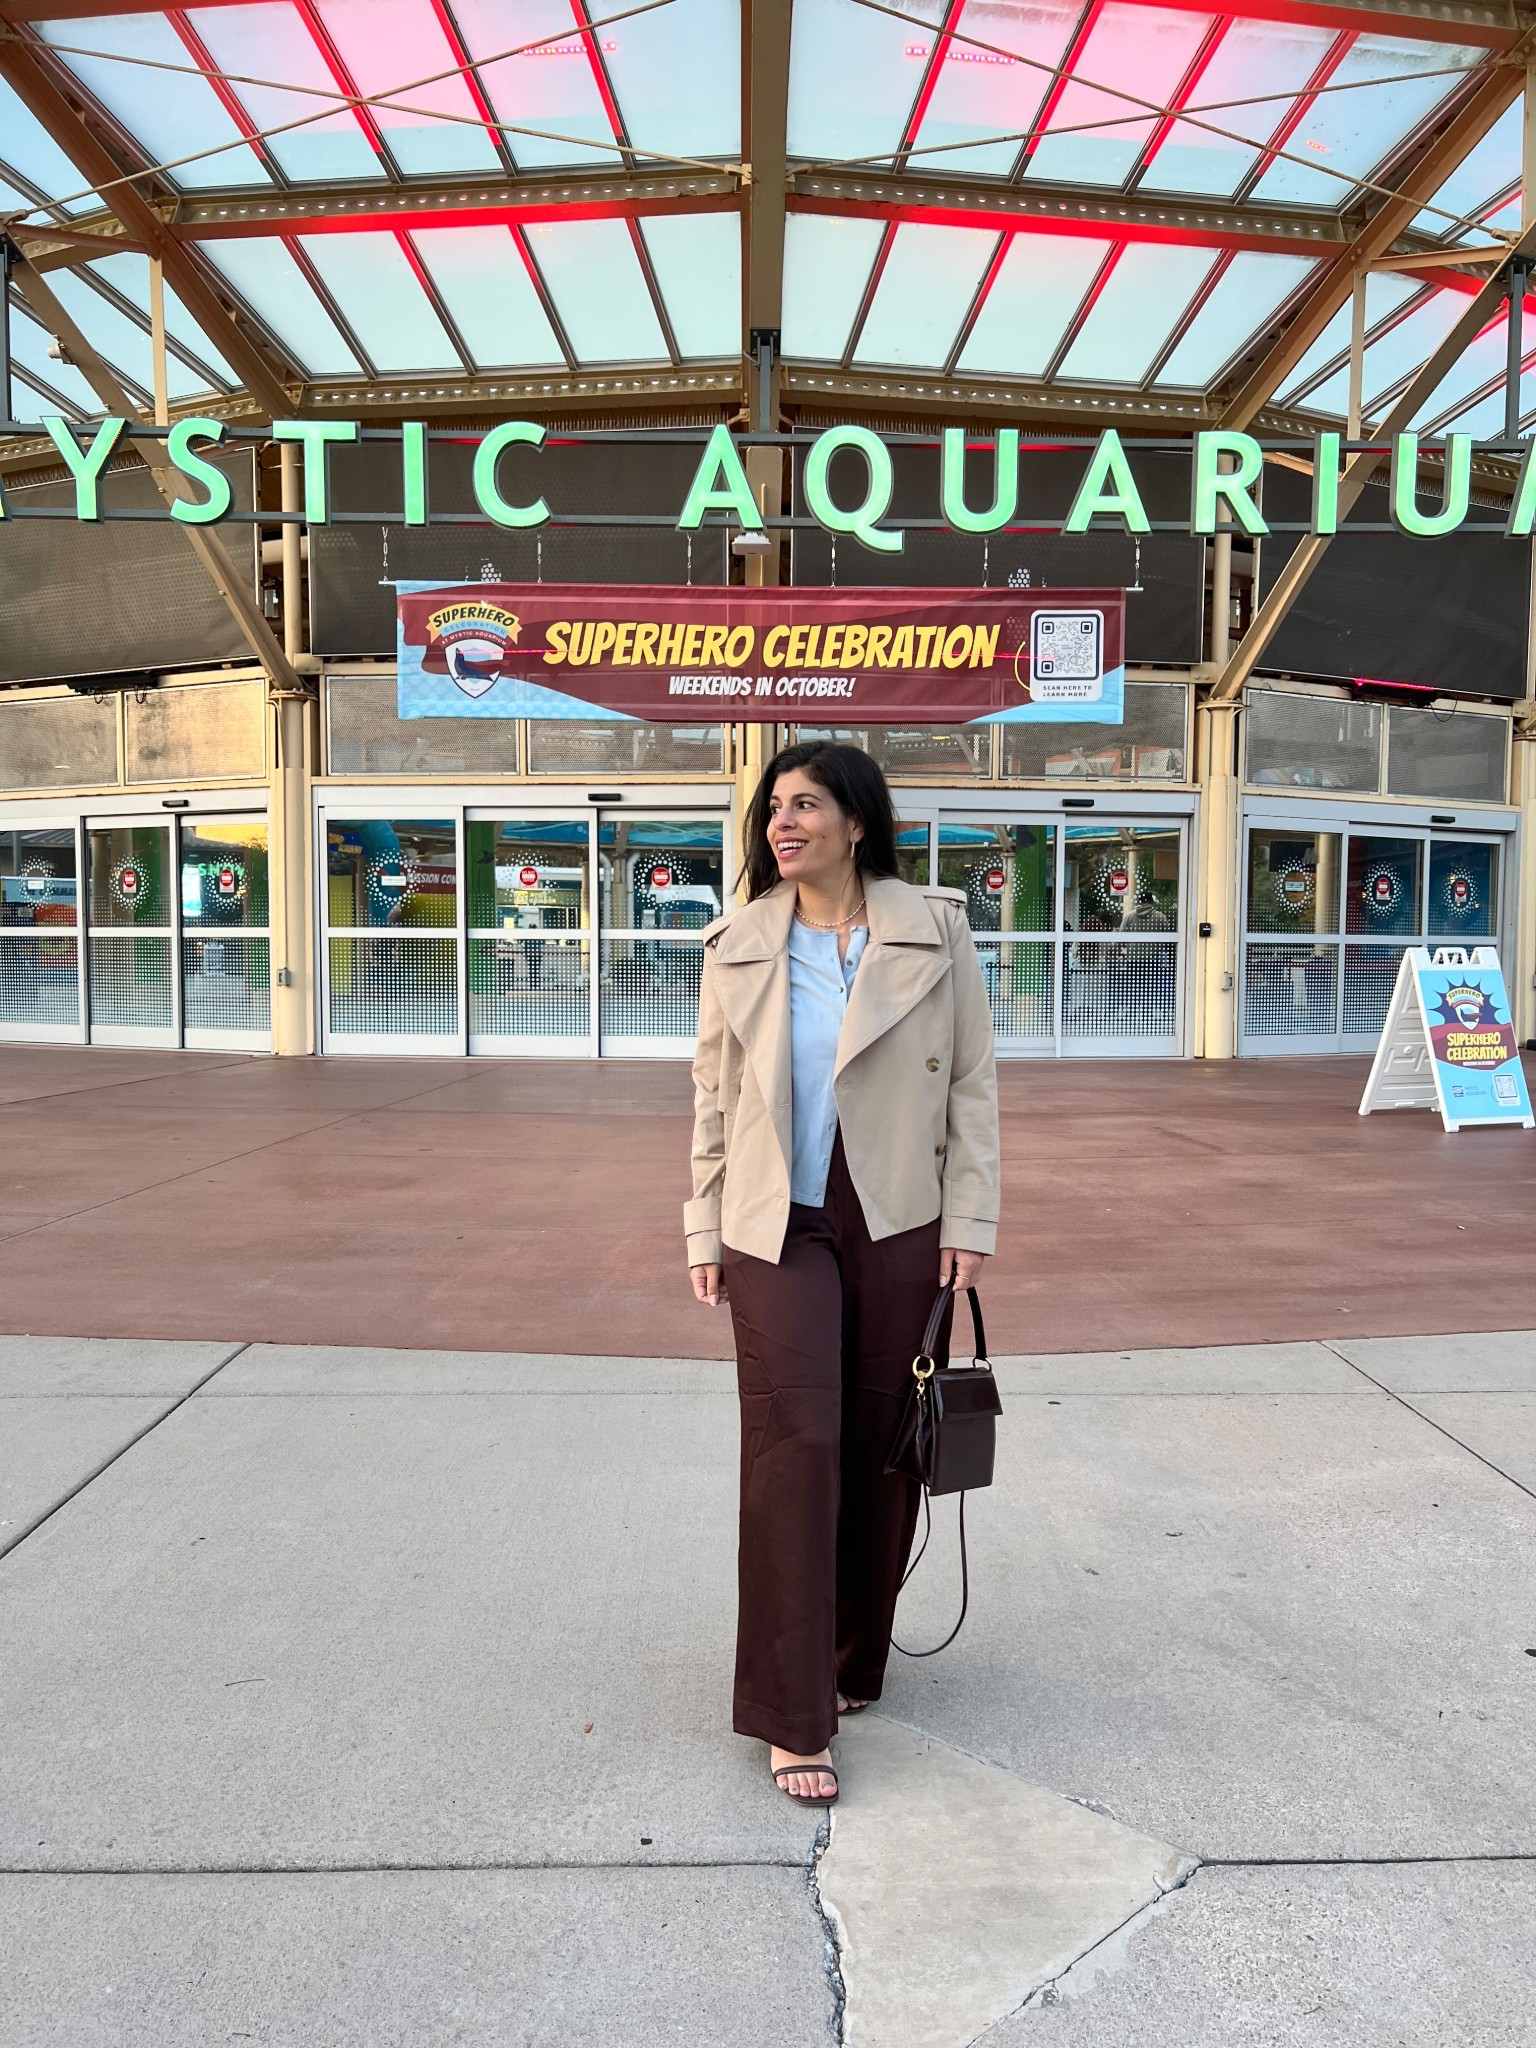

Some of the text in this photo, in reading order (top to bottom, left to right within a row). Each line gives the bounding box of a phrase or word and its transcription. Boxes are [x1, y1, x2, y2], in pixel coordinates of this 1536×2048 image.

[0, 416, 553, 529] YSTIC
[433, 606, 515, 628] SUPERHERO
[444, 621, 506, 635] CELEBRATION
[449, 631, 473, 640] MYSTIC
[475, 631, 507, 646] AQUARIUM
[543, 622, 1001, 669] SUPERHERO CELEBRATION
[668, 676, 857, 698] WEEKENDS IN OCTOBER!
[1448, 989, 1480, 999] SUPERHERO
[1446, 1031, 1501, 1046] SUPERHERO
[1446, 1046, 1508, 1061] CELEBRATION
